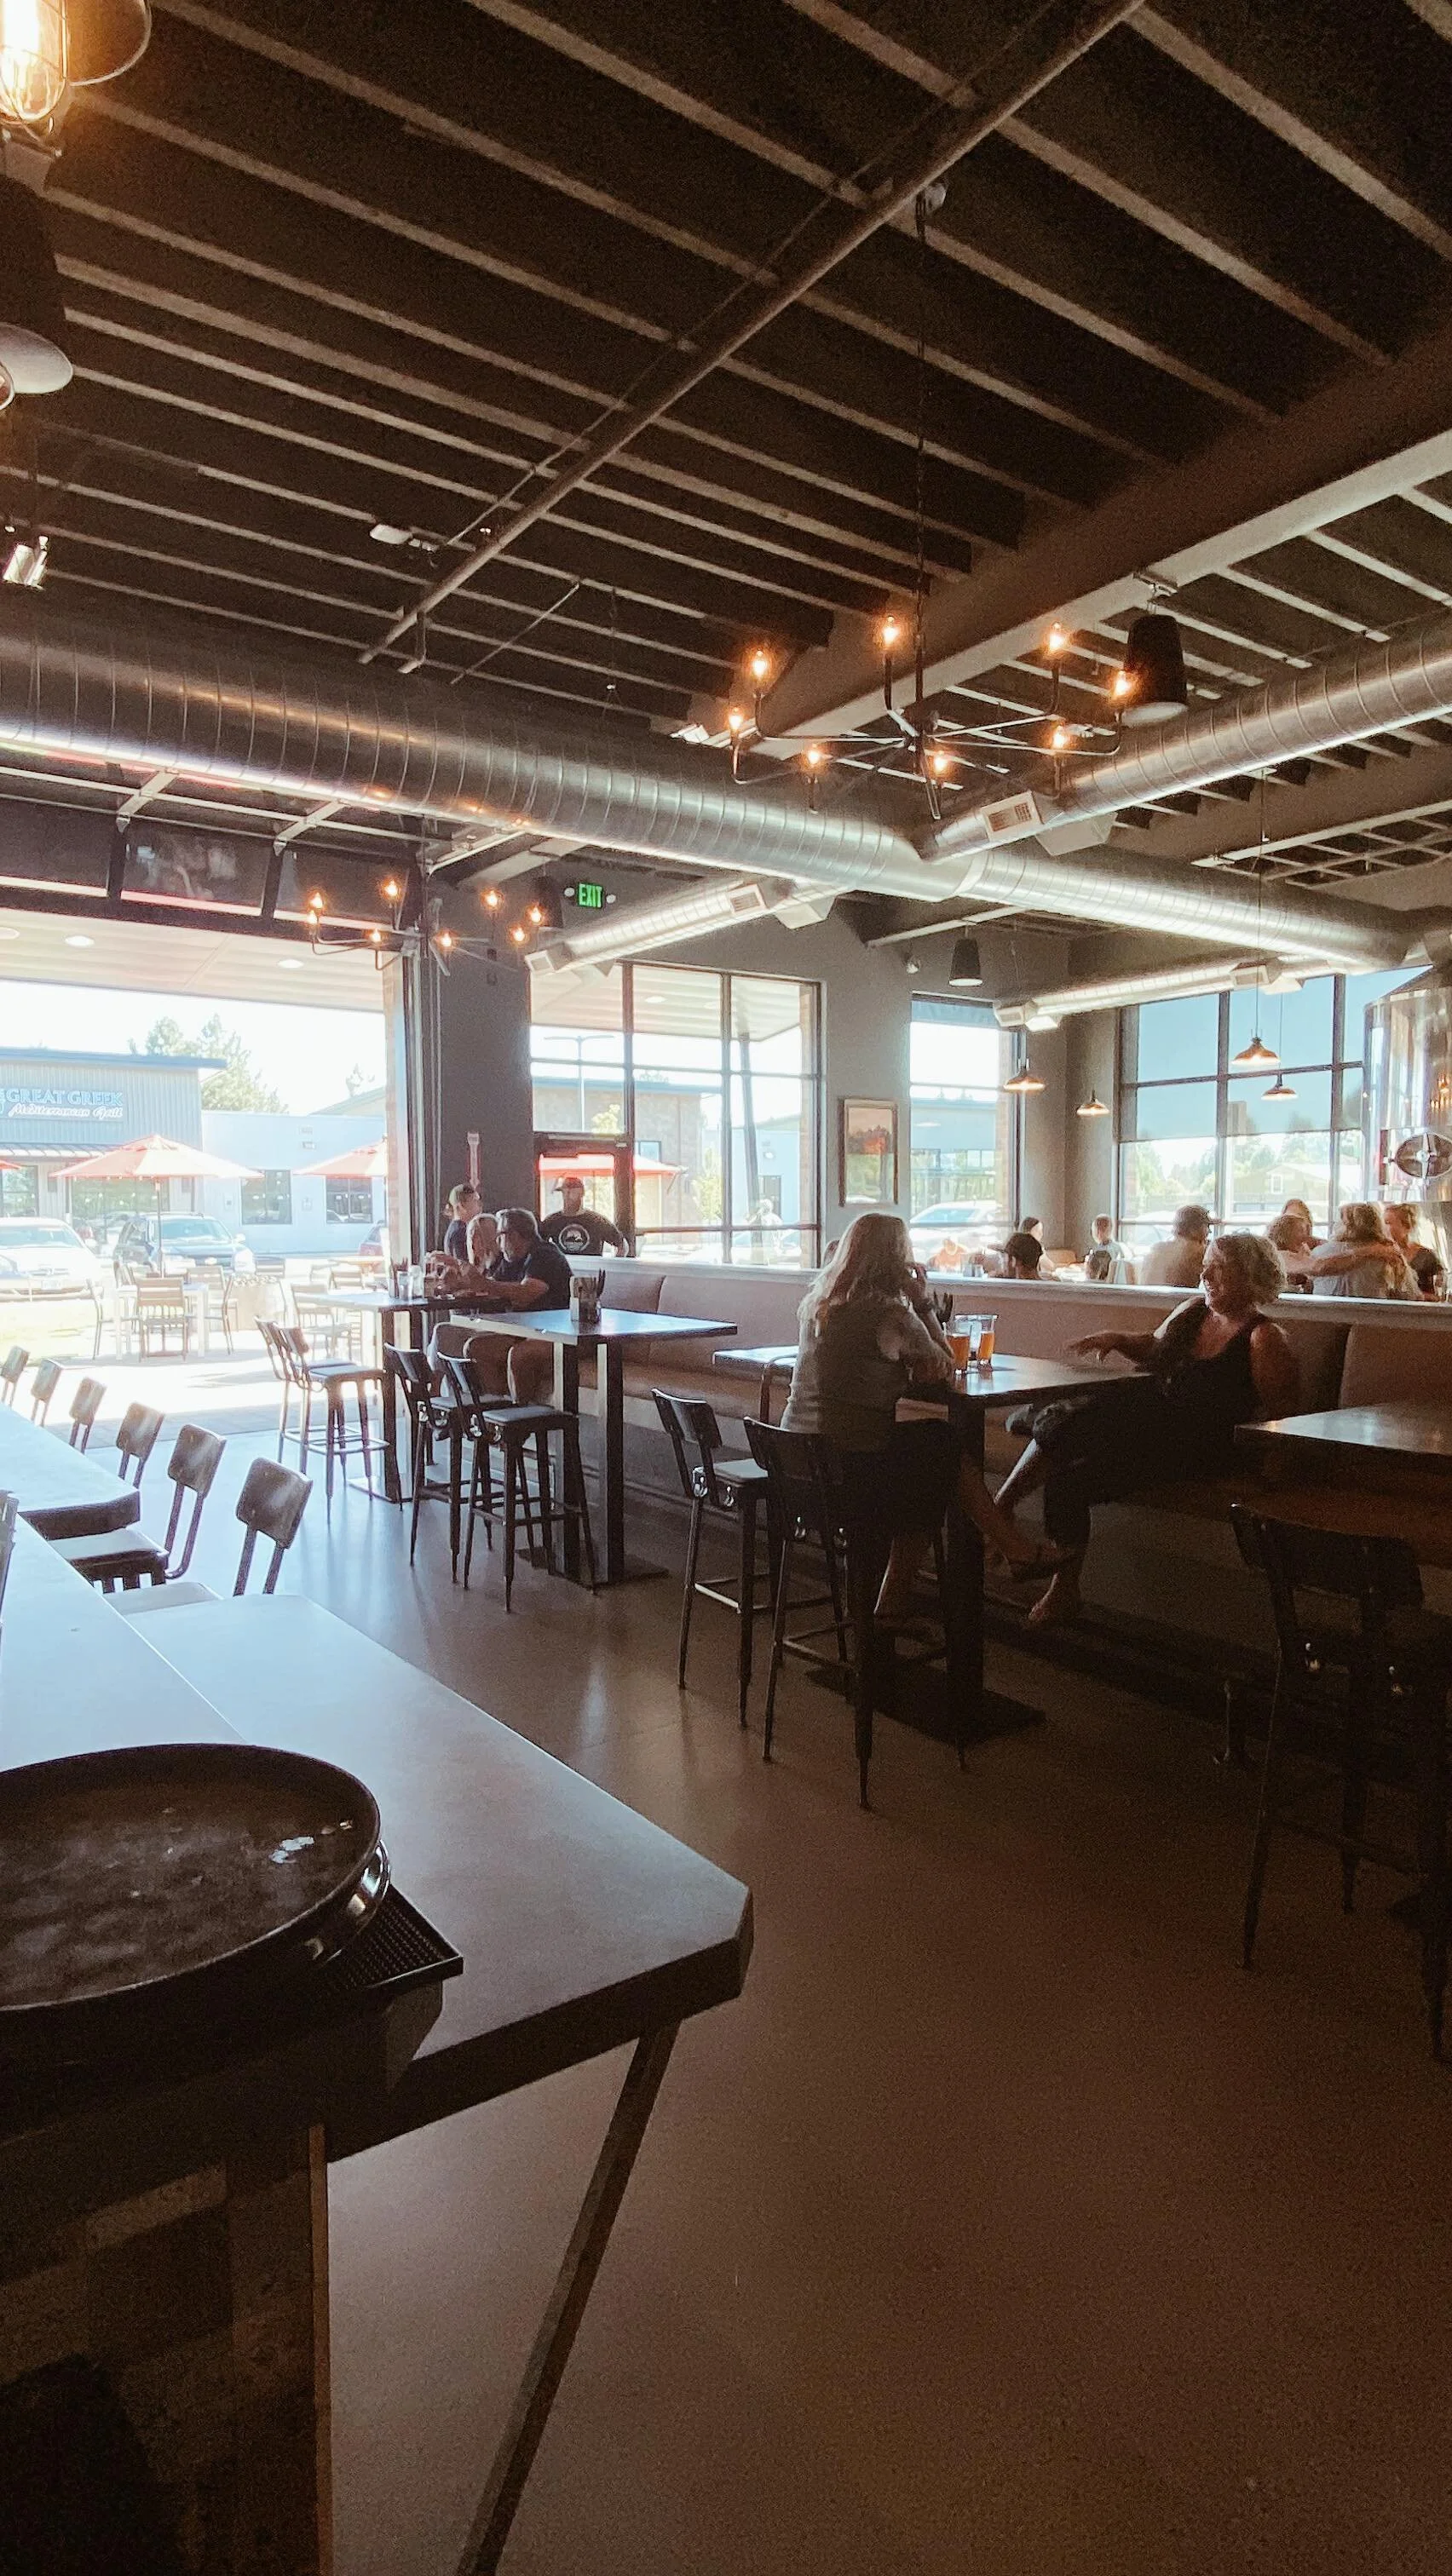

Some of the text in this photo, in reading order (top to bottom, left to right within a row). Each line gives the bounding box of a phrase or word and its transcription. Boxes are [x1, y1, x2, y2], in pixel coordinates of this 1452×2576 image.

[579, 883, 602, 907] EXIT
[6, 1089, 65, 1105] GREAT
[67, 1090, 124, 1106] GREEK
[9, 1103, 124, 1119] Mediterranean Grill
